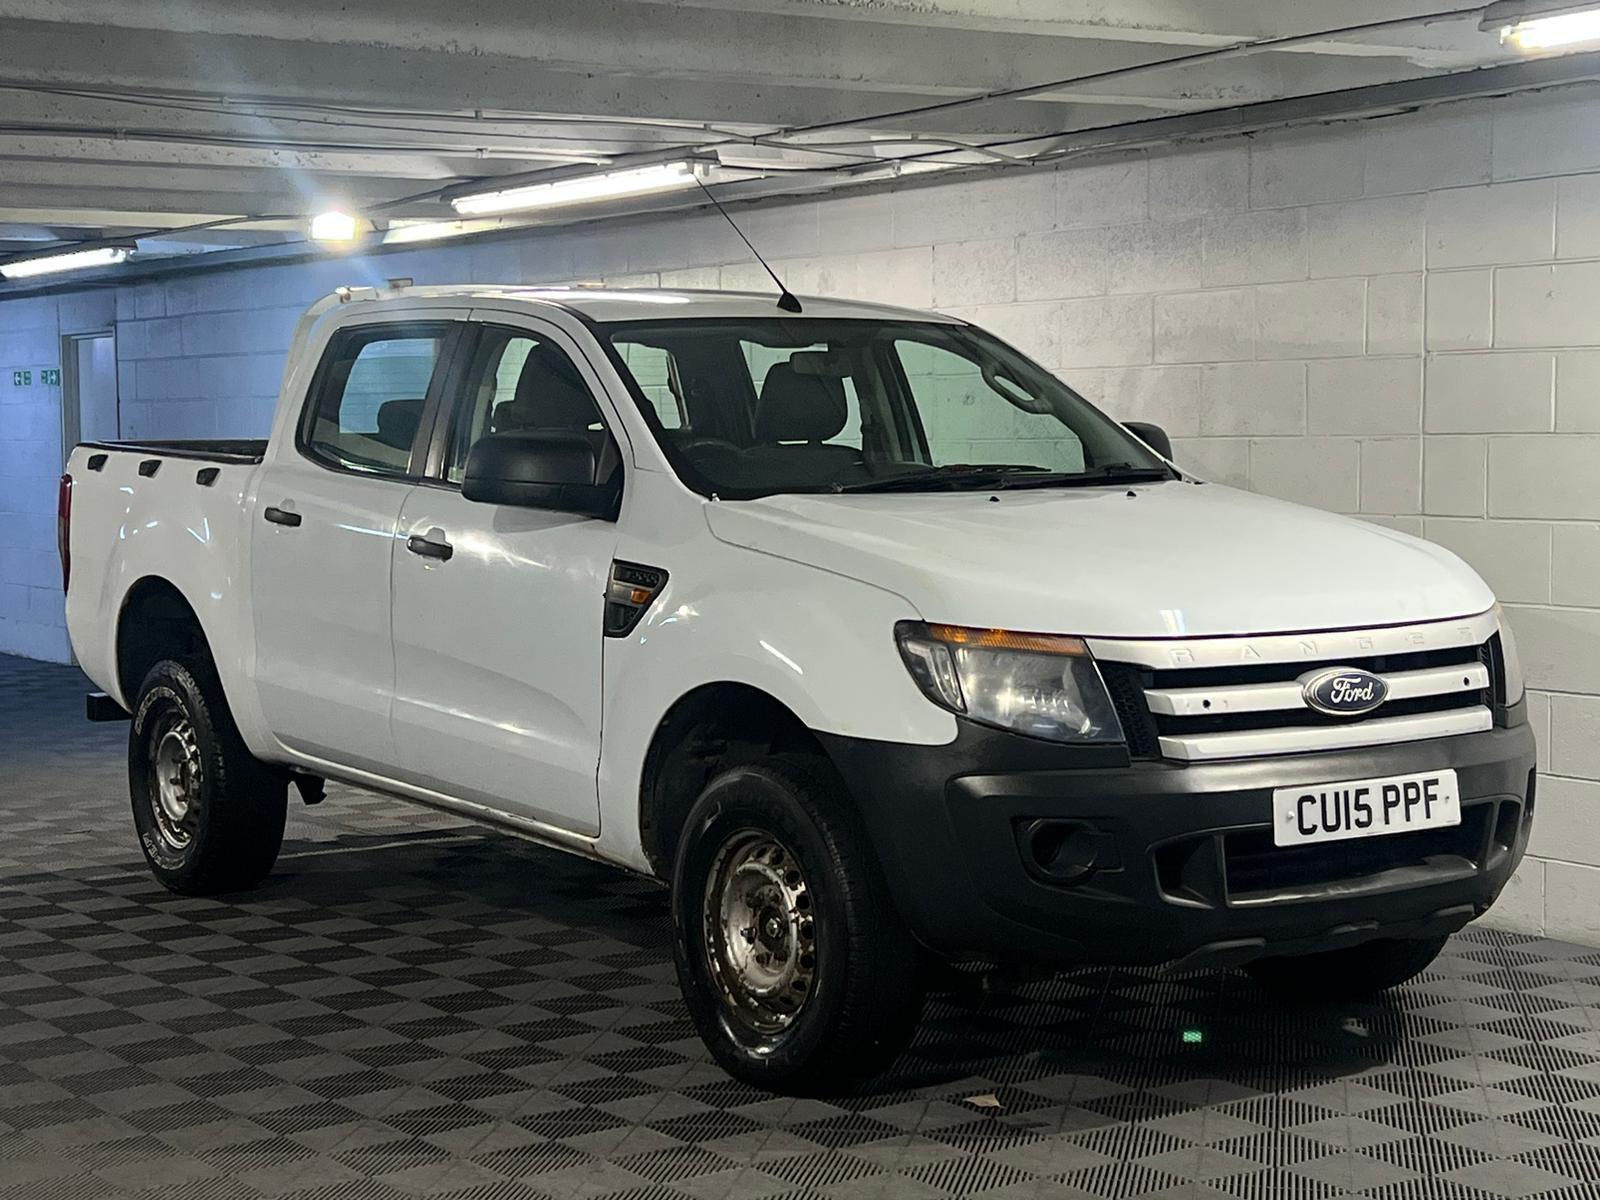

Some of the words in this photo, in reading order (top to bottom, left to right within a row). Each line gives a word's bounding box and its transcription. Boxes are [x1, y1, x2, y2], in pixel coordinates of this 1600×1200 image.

[1331, 677, 1374, 703] Ford
[1297, 788, 1372, 835] CU15
[1382, 778, 1439, 825] PPF
